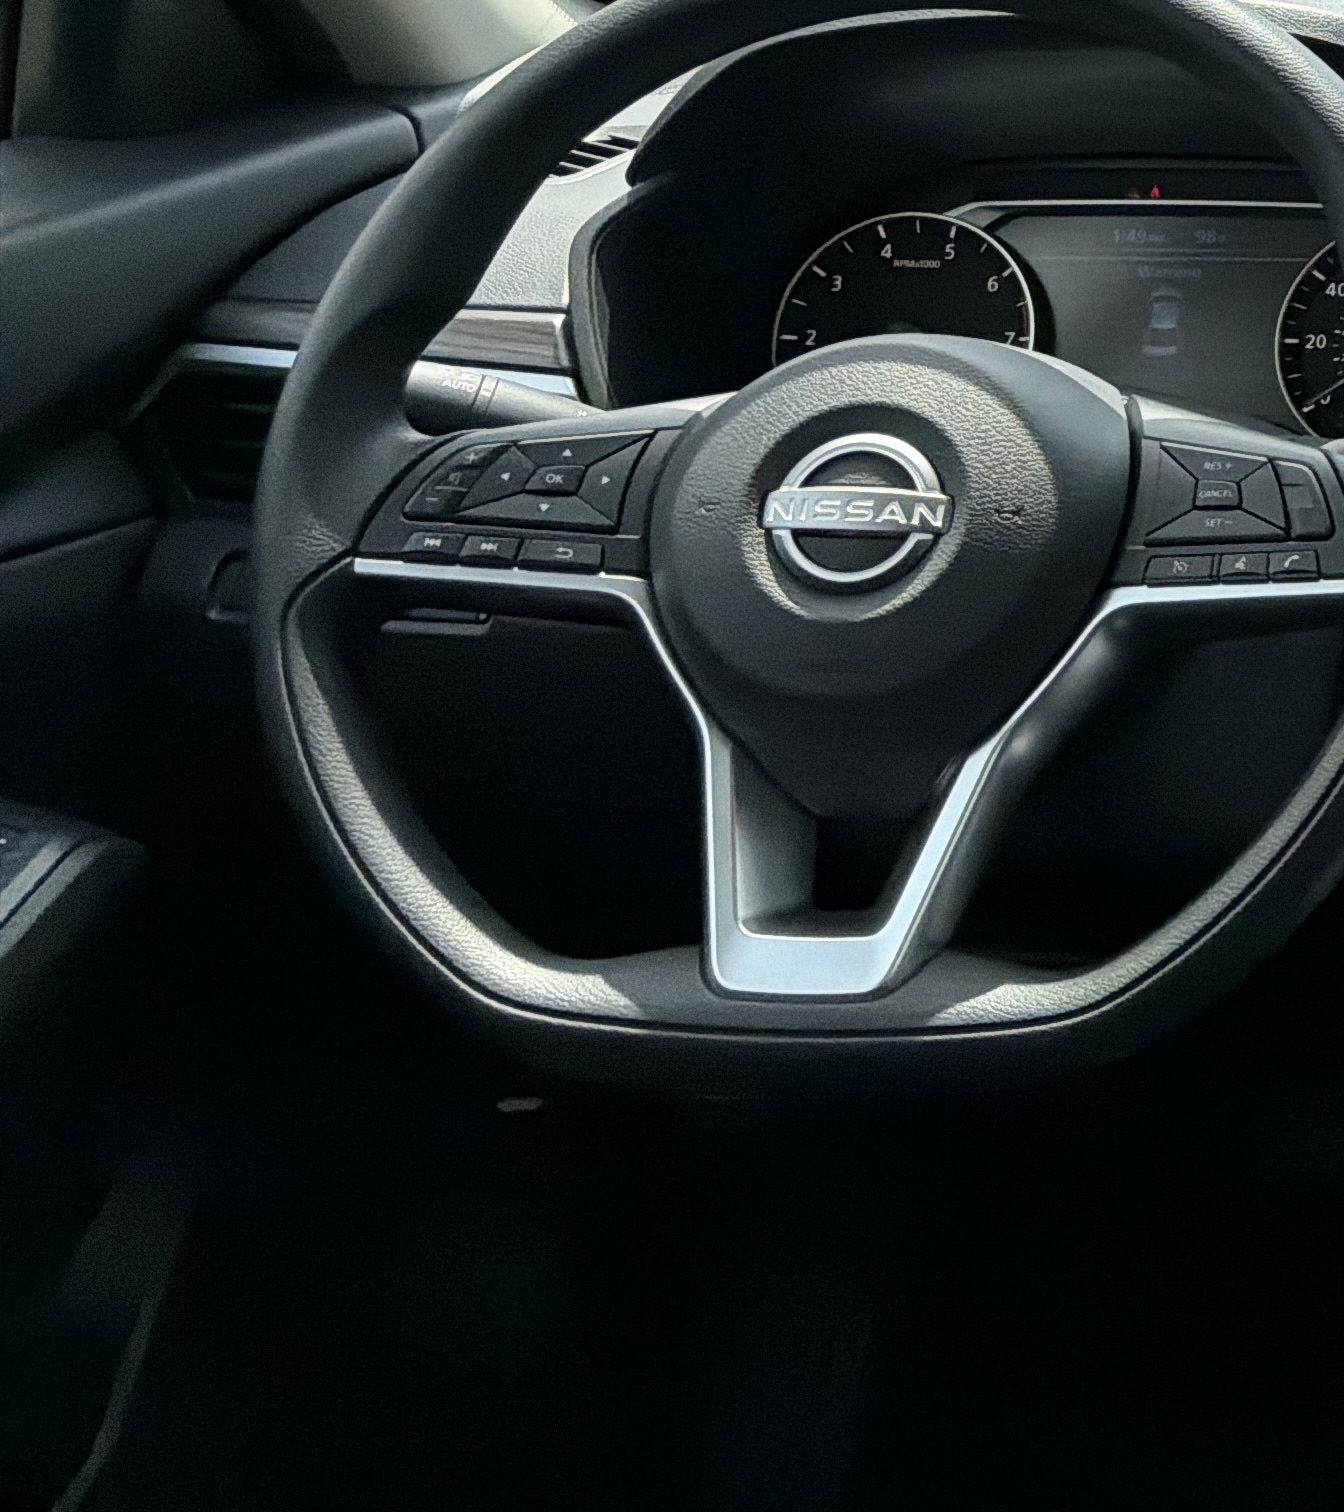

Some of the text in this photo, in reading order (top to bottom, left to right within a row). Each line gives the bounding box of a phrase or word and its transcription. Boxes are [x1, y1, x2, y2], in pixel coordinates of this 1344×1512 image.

[881, 244, 892, 258] 4
[945, 244, 955, 260] 5
[832, 276, 842, 292] 3
[987, 276, 999, 292] 6
[805, 330, 817, 346] 2
[1004, 332, 1016, 345] 7
[1304, 335, 1327, 349] 20
[442, 379, 477, 392] AUTO
[1203, 461, 1222, 471] RES
[545, 473, 564, 484] OK
[1199, 489, 1233, 498] CANCEL
[766, 499, 946, 528] NISSAN
[1204, 518, 1221, 528] SET
